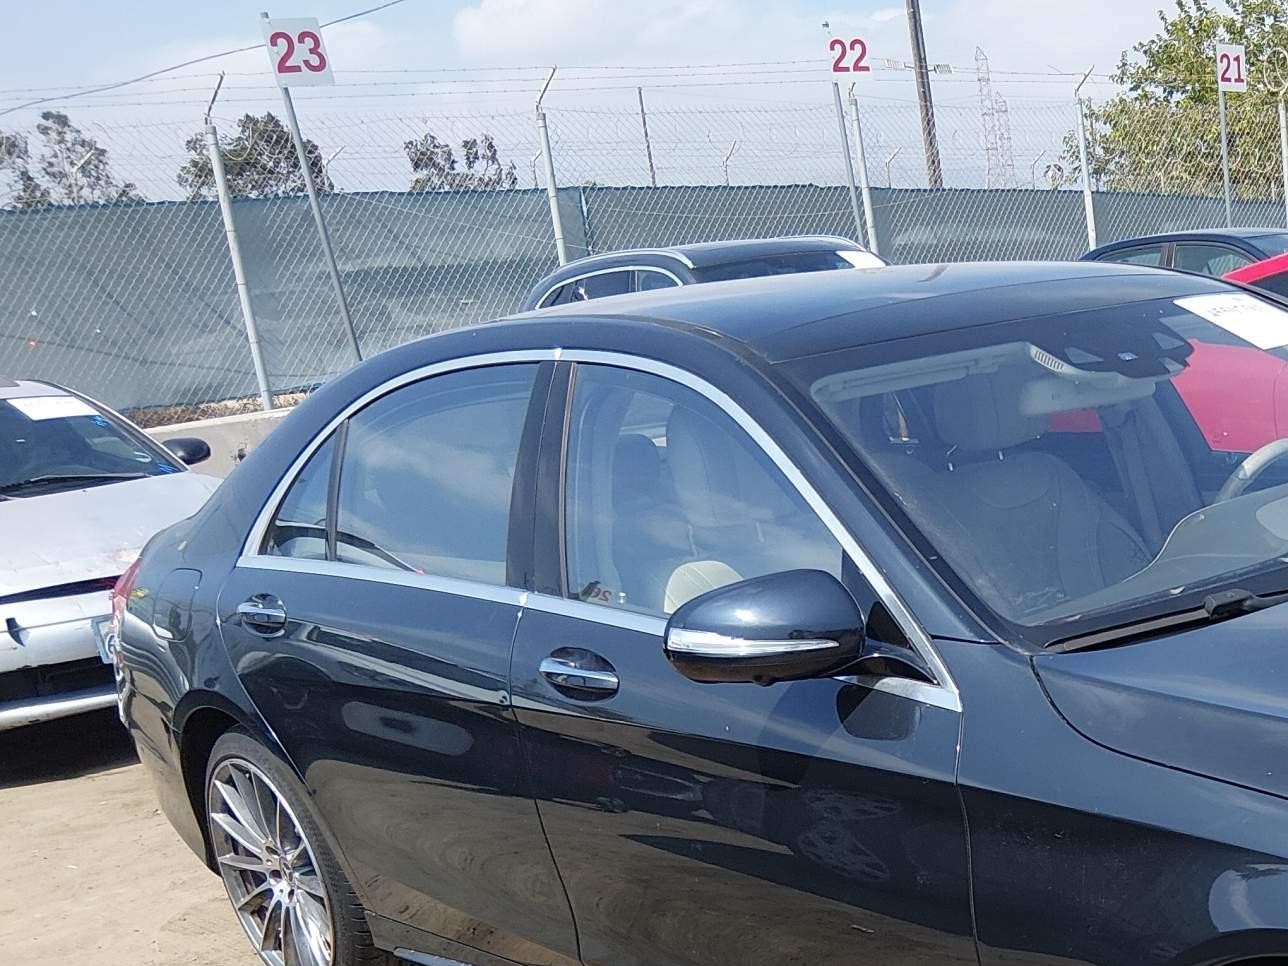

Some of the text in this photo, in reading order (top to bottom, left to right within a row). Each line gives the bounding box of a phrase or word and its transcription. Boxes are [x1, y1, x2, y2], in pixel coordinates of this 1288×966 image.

[269, 30, 327, 74] 23
[829, 38, 871, 73] 22
[1219, 52, 1245, 84] 21
